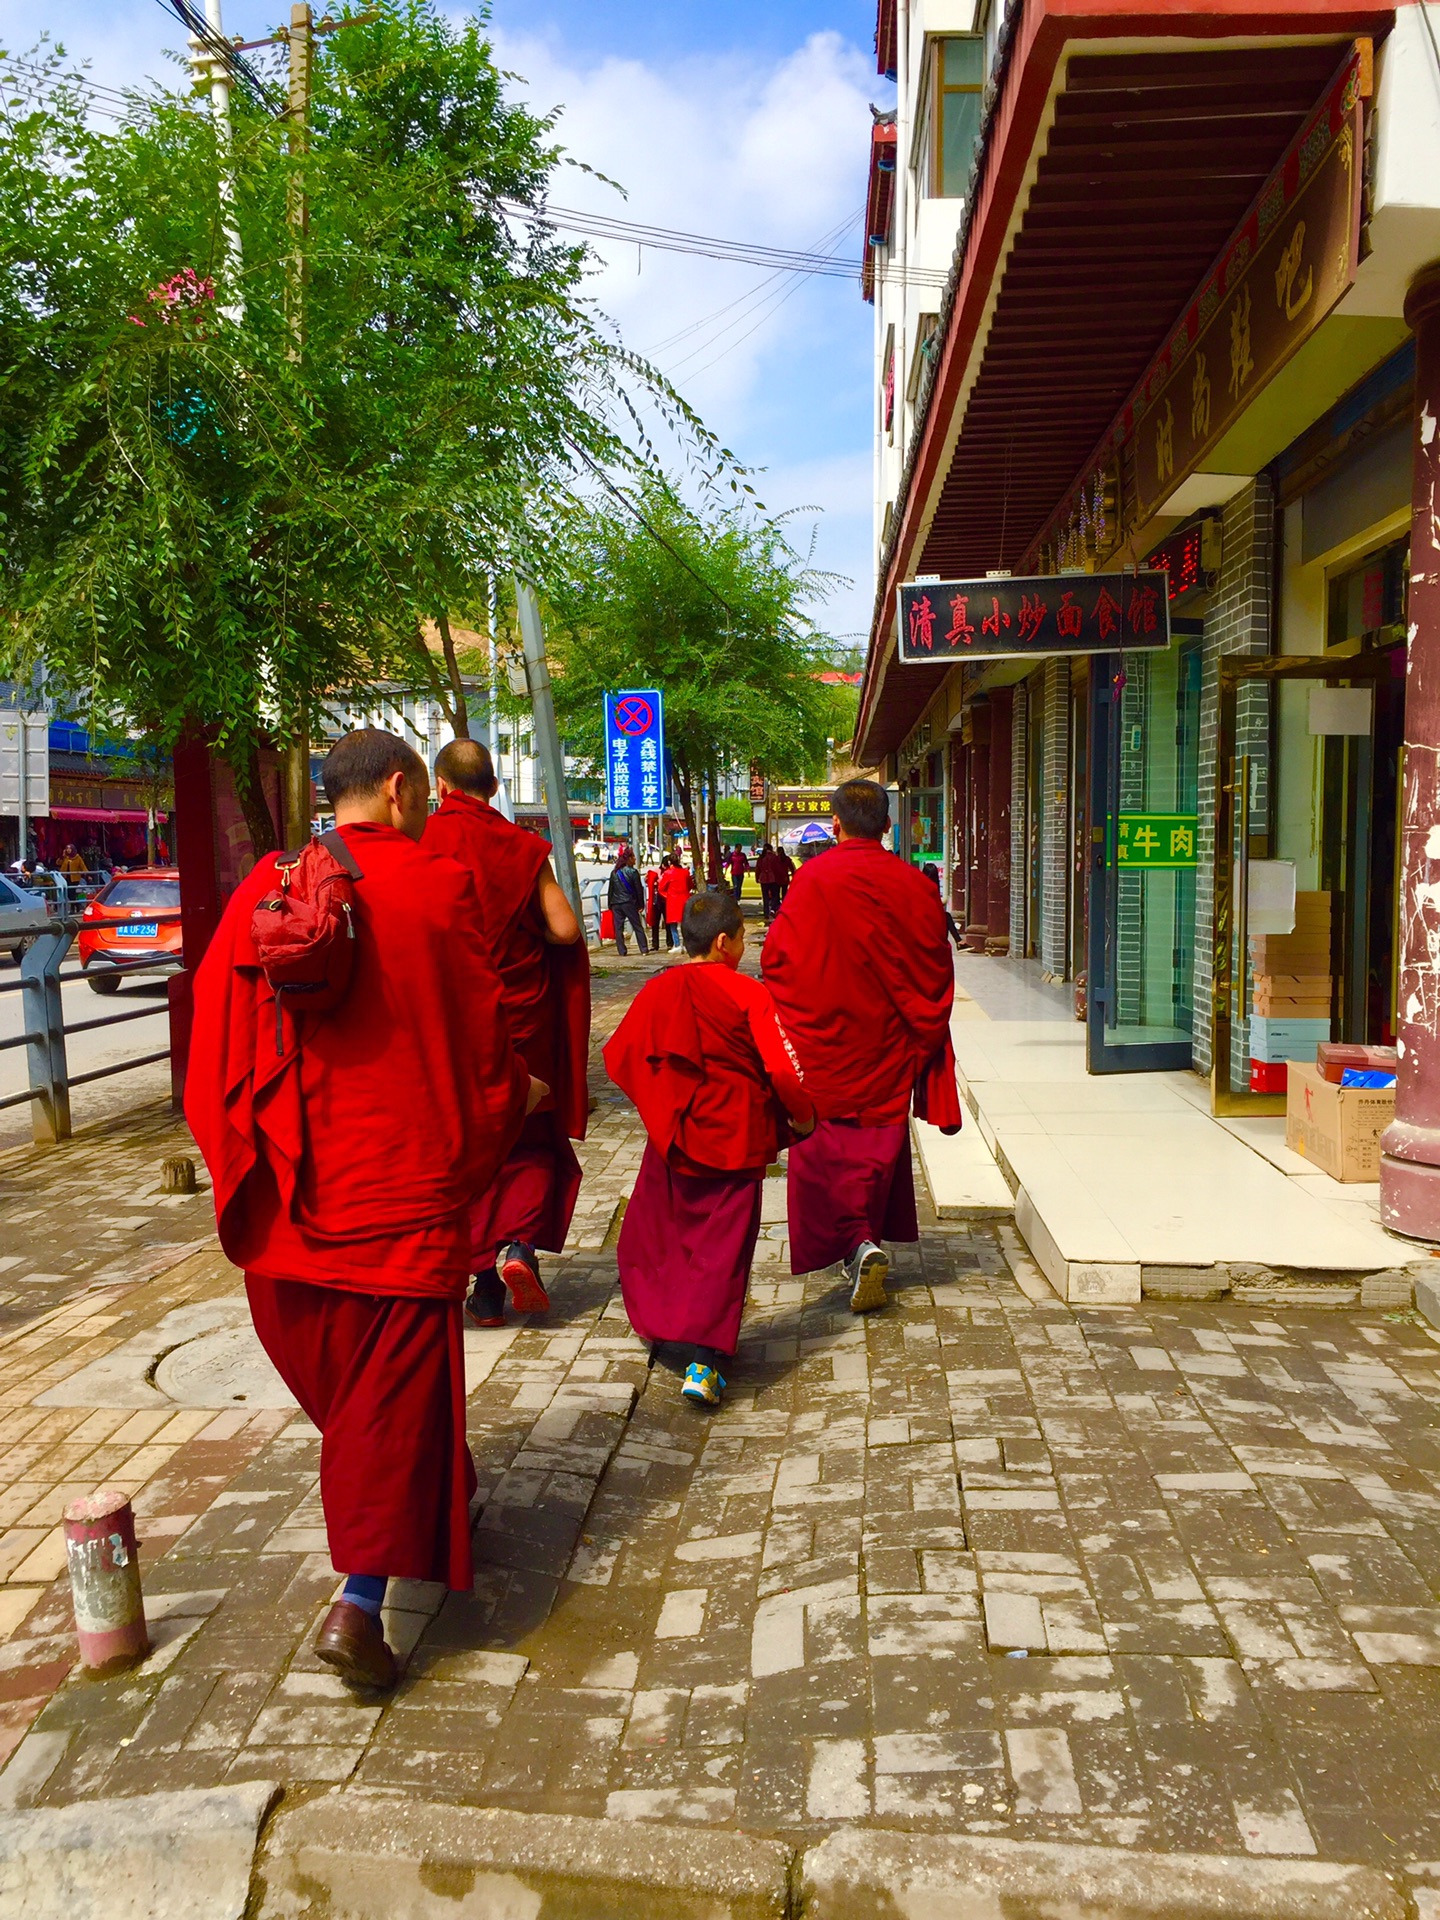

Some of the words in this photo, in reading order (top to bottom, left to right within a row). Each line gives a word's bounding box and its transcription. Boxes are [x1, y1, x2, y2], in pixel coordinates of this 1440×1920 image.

[908, 584, 1159, 650] 清真小炒面食馆
[612, 738, 630, 808] 电子监控路段
[640, 737, 658, 808] 全线禁止停车
[1133, 825, 1193, 857] 牛肉
